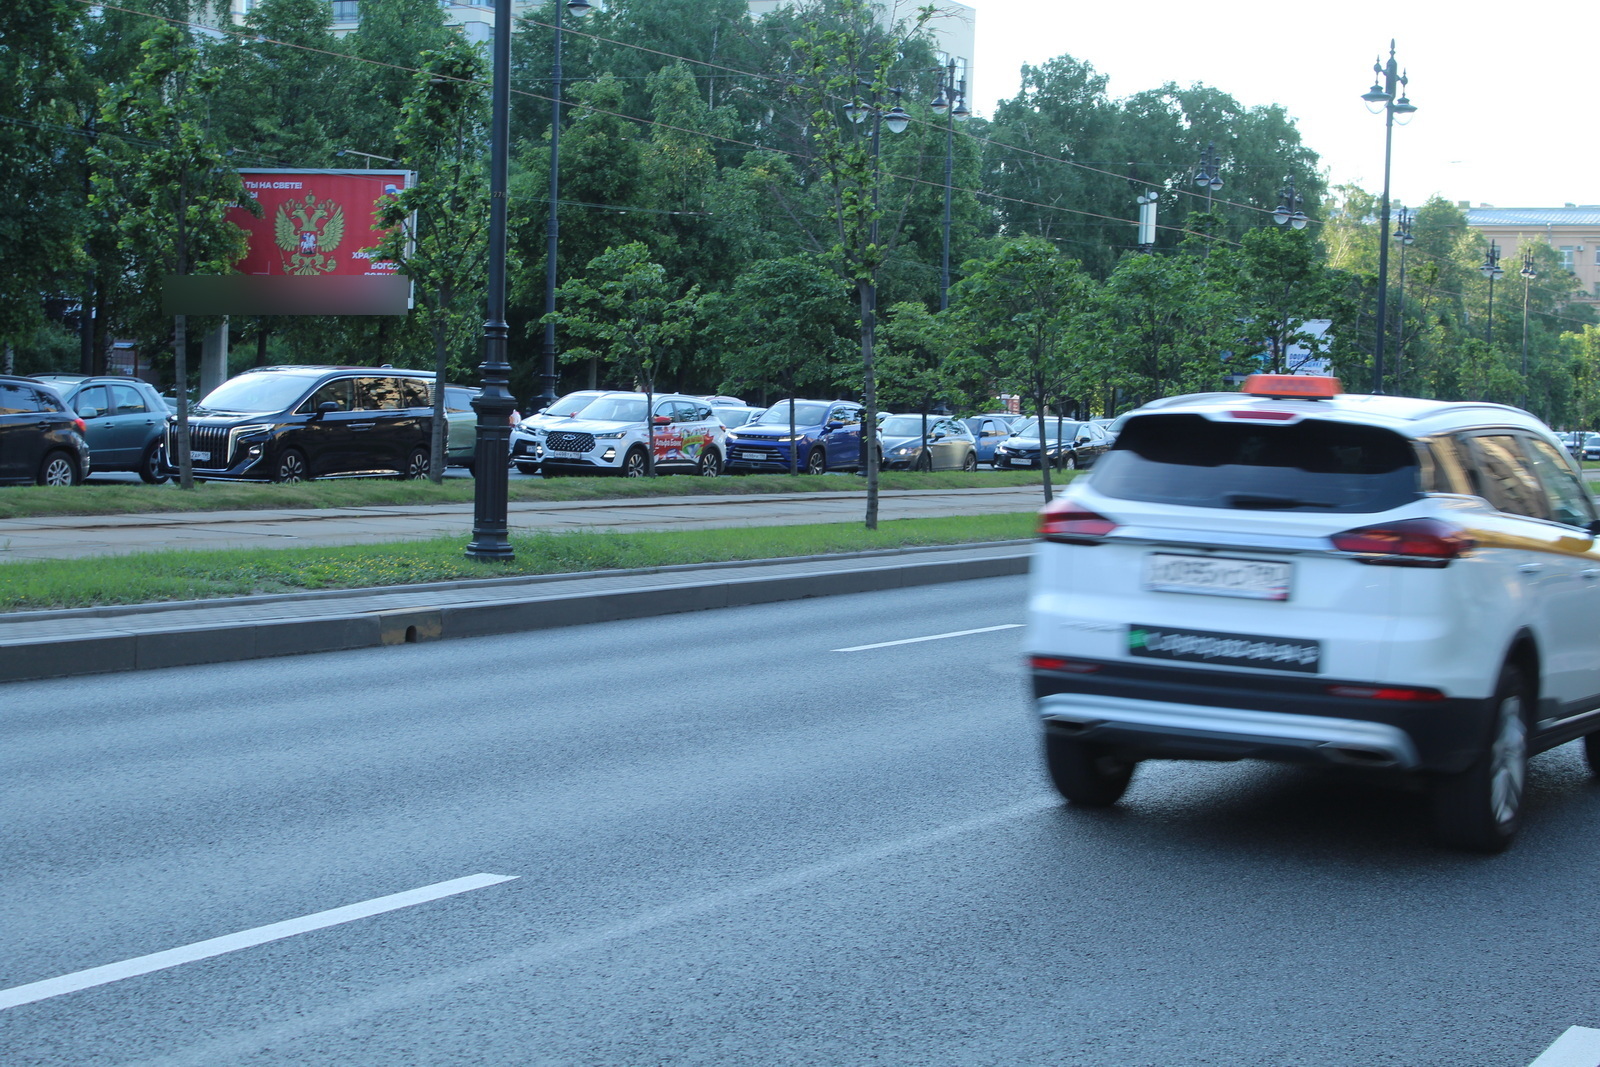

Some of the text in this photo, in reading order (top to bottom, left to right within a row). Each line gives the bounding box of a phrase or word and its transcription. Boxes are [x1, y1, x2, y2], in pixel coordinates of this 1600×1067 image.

[245, 181, 303, 190] ТЫ НА СВЕТЕ!
